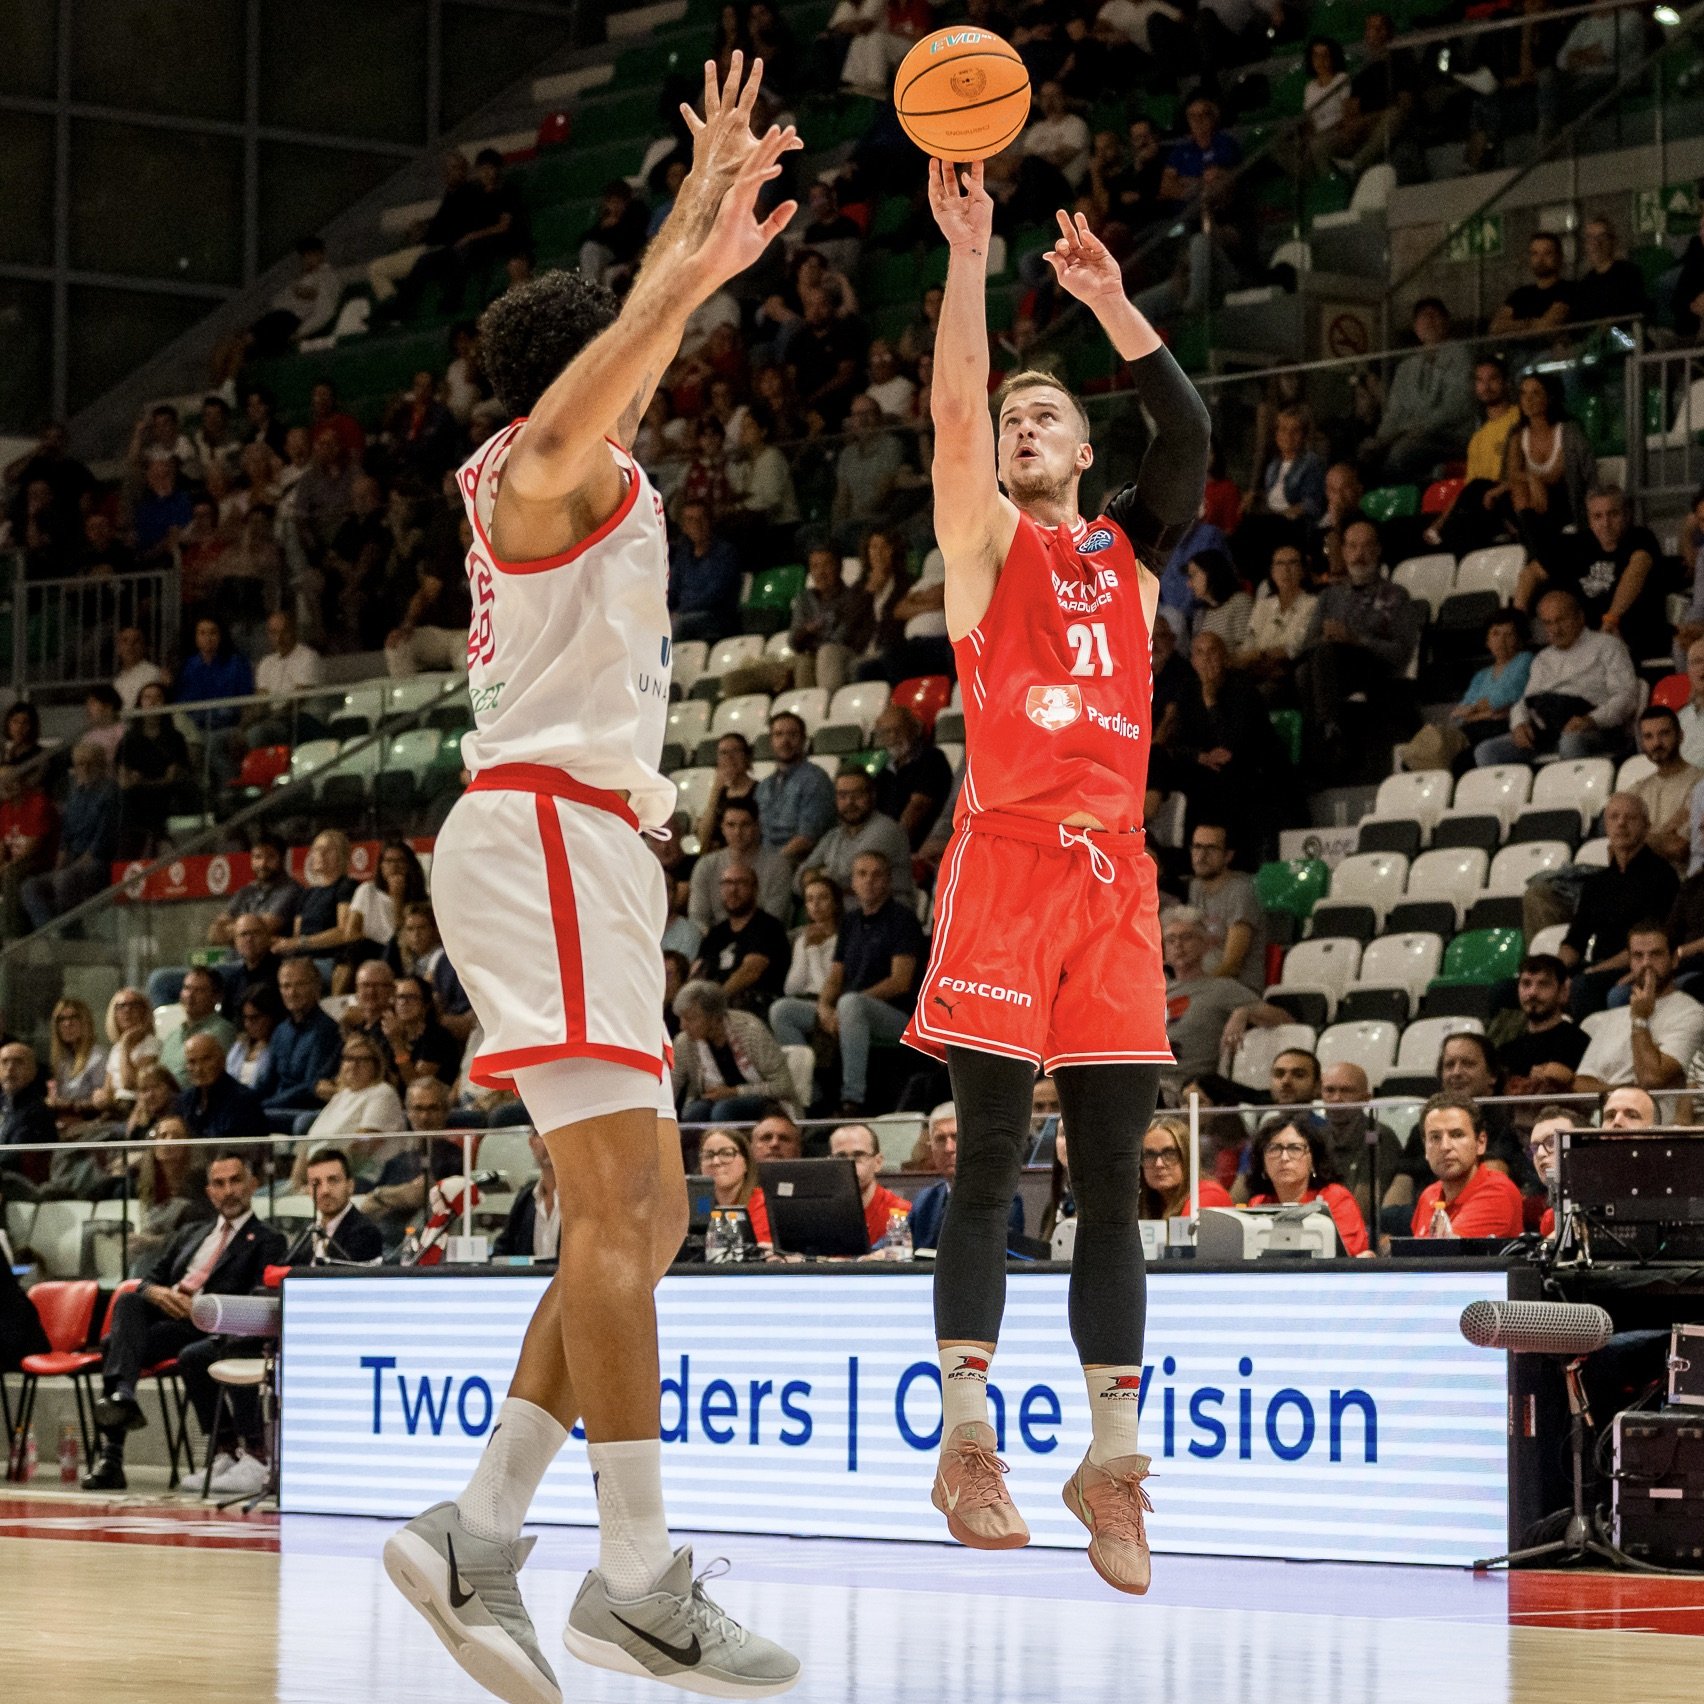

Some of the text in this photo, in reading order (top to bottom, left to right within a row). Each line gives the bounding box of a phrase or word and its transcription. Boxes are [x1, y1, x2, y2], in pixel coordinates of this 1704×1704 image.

[1051, 569, 1119, 602] BK KVIS
[1066, 622, 1114, 677] 21
[1086, 705, 1140, 740] Pardice
[360, 1356, 493, 1436] Two
